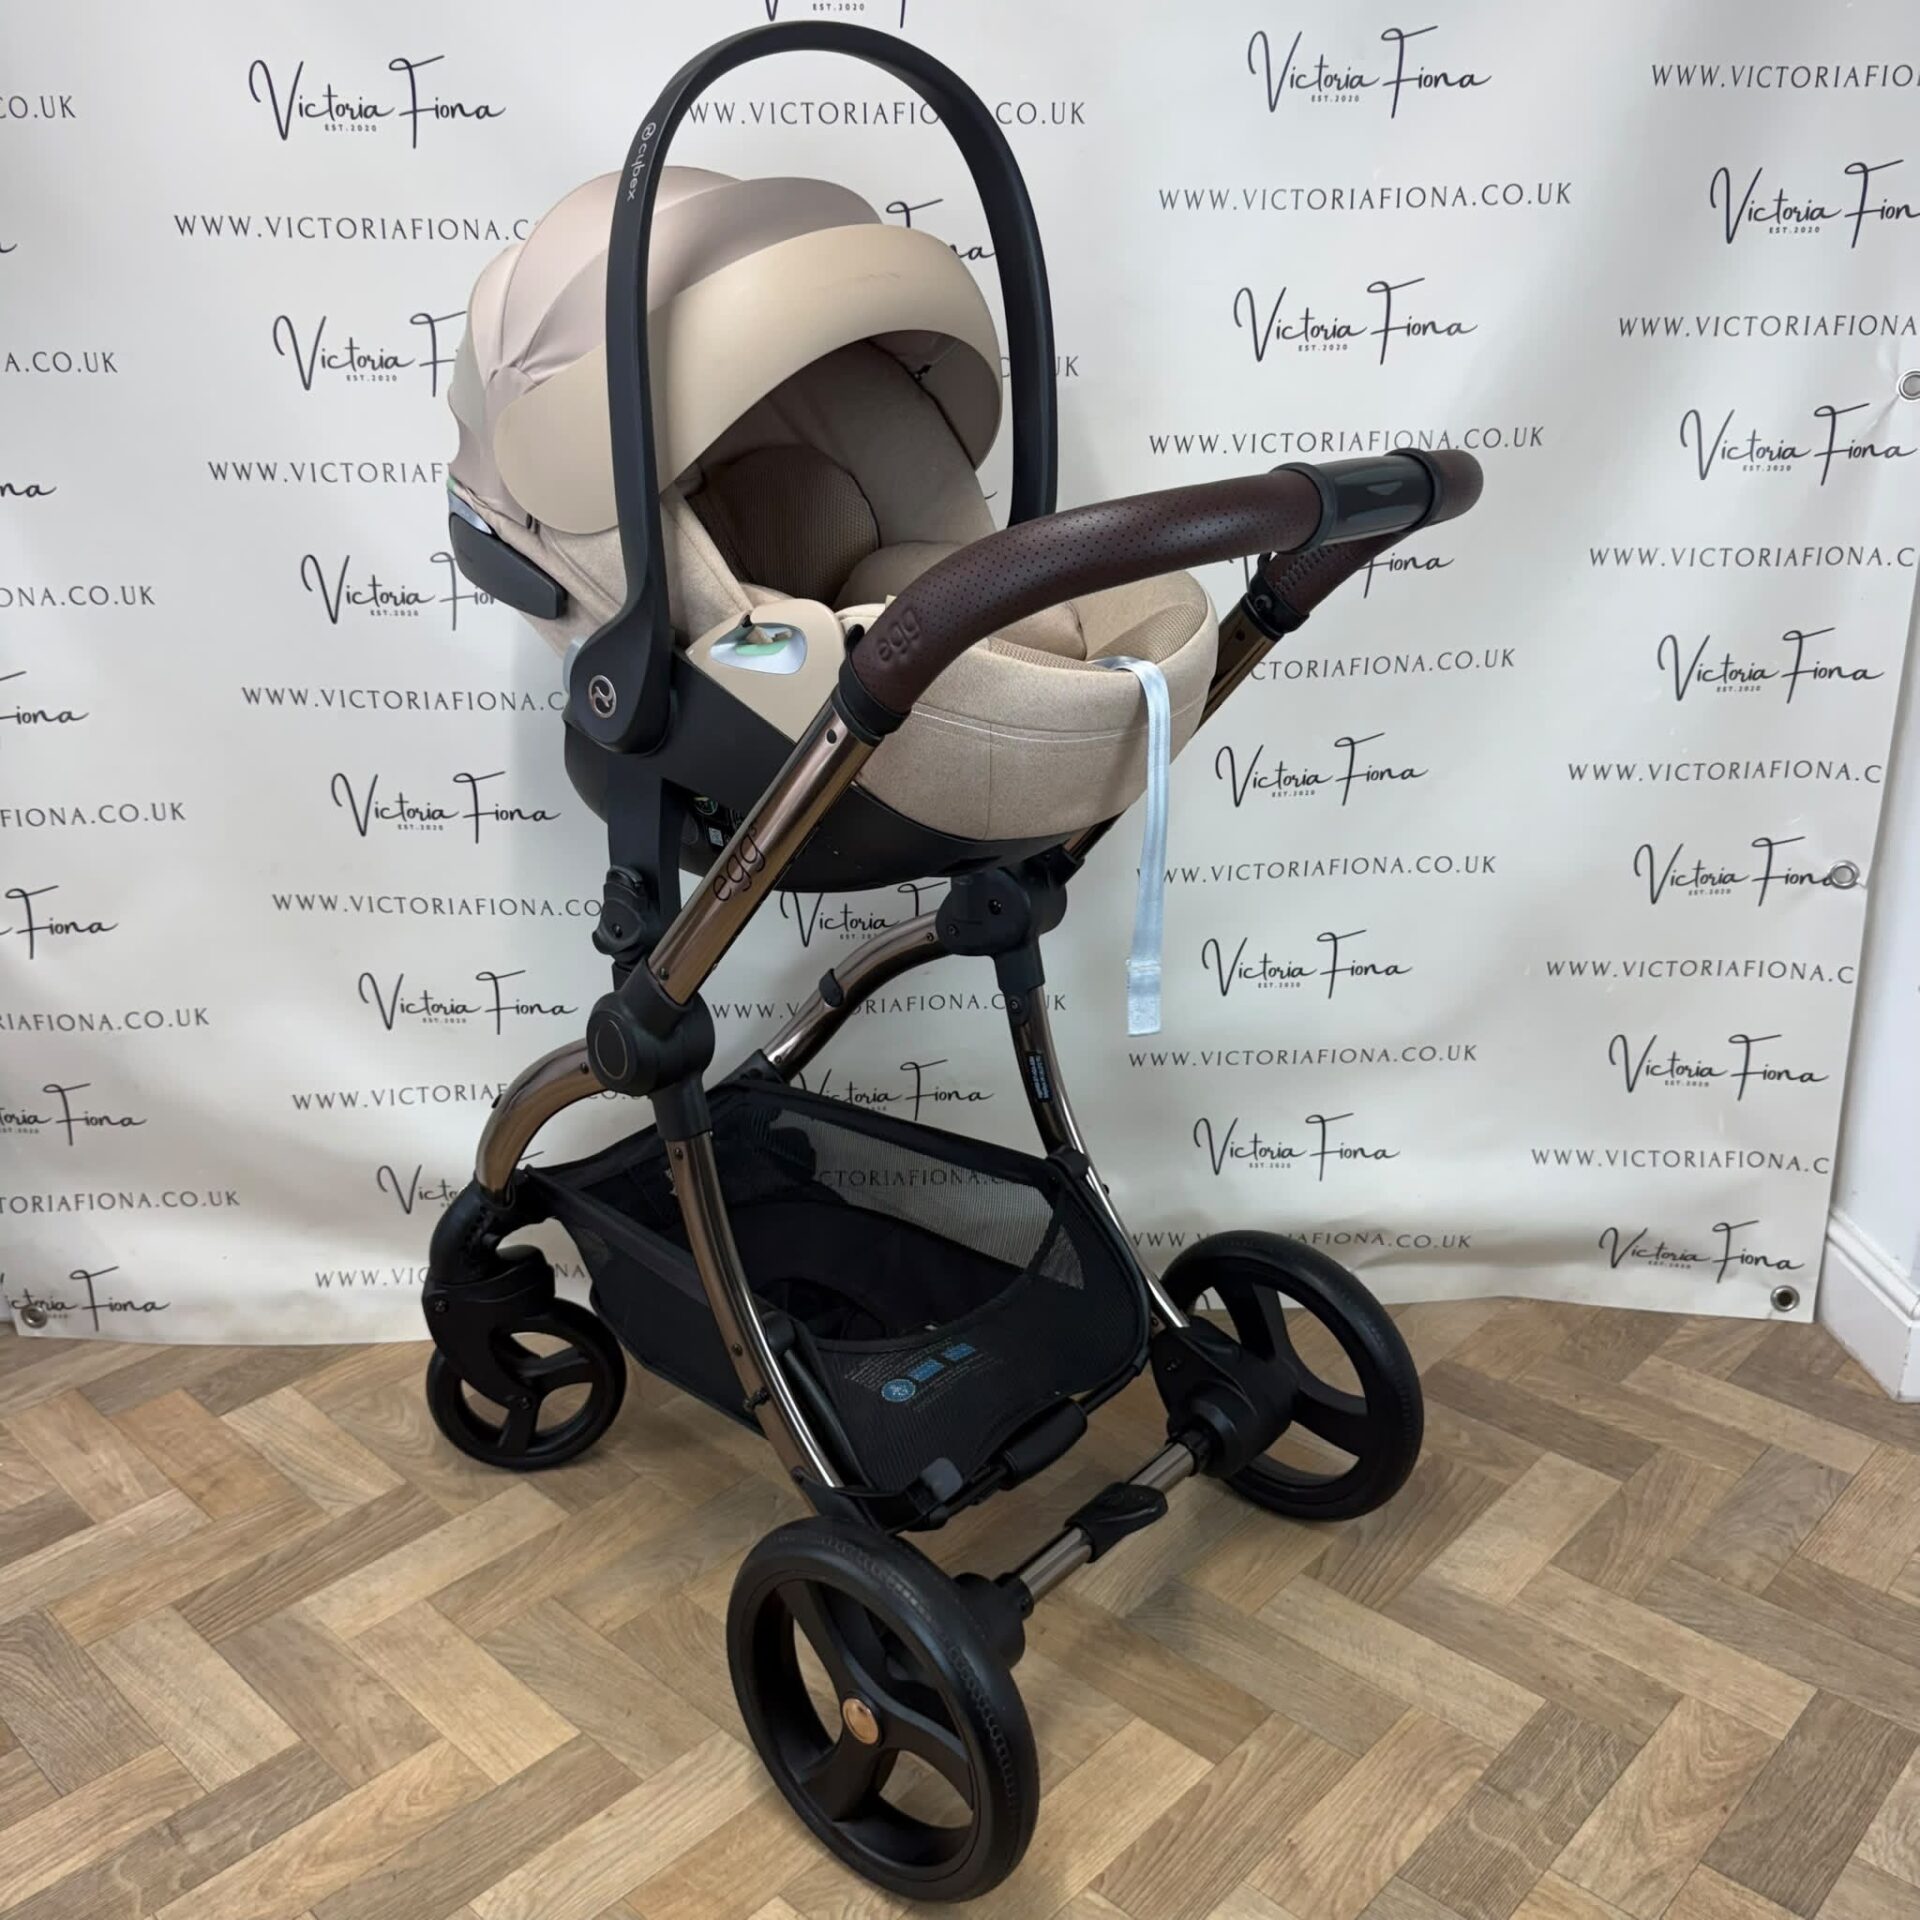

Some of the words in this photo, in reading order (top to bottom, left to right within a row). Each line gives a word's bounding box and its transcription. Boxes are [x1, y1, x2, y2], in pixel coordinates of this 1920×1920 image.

[812, 3, 865, 11] EST.2020
[249, 60, 396, 140] Victoria
[389, 55, 506, 149] Fiona
[1248, 30, 1380, 112] Victoria
[1381, 26, 1492, 118] Fiona
[1311, 94, 1360, 103] EST.2020
[1651, 65, 1920, 88] WWW.VICTORIAFIO
[324, 124, 377, 132] EST.2020
[626, 142, 648, 202] cybex
[1159, 182, 1572, 211] WWW.VICTORIAFIONA.CO.UK
[174, 215, 529, 241] WWW.VICTORIAFIONA.C
[1710, 167, 1842, 244] Victoria
[1844, 160, 1920, 249] Fion
[1769, 226, 1820, 234] EST.2020
[1234, 287, 1367, 362] Victoria
[1367, 278, 1478, 365] Fiona
[1298, 343, 1348, 352] EST.2020
[1618, 315, 1917, 338] WWW.VICTORIAFIONA
[273, 315, 416, 391] Victoria
[346, 374, 397, 382] EST.2020
[208, 462, 442, 484] WWW.VICTORIAF
[1680, 409, 1812, 480] Victoria
[1813, 403, 1918, 486] Fiona
[1590, 547, 1914, 567] WWW.VICTORIAFIONA.C
[301, 555, 435, 624] Victoria
[430, 552, 495, 631] Fio
[1251, 648, 1516, 681] CTORIAFIONA.CO.UK
[1657, 634, 1780, 701] Victoria
[1781, 627, 1885, 704] Fiona
[0, 671, 89, 725] iona
[242, 687, 564, 711] WWW.VICTORIAFIONA.C
[1215, 744, 1334, 808] Victoria
[1333, 732, 1428, 806] Fiona
[1568, 760, 1882, 784] WWW.VICTORIAFIONA.C
[331, 773, 459, 837] Victoria
[453, 771, 561, 844] Fiona
[713, 833, 766, 902] egg
[1136, 856, 1496, 886] WW.VICTORIAFIONA.CO.UK
[1634, 843, 1749, 905] Victoria
[5, 886, 119, 960] Fiona
[272, 894, 601, 917] WWW.VICTORIAFIONA.CO
[1202, 937, 1316, 996] Victoria
[1317, 930, 1413, 999] Fiona
[1546, 960, 1854, 984] WWW.VICTORIAFIONA.C
[358, 972, 481, 1031] Victoria
[475, 970, 578, 1035] Fiona
[1129, 1045, 1477, 1067] WWW.VICTORIAFIONA.CO.UK
[1609, 1034, 1727, 1093] Victoria
[1728, 1034, 1830, 1101] Fiona
[43, 1083, 147, 1146] Fiona
[900, 1059, 994, 1121] Fiona
[1194, 1117, 1307, 1175] Victoria
[1305, 1113, 1400, 1181] Fiona
[1531, 1148, 1829, 1175] WWW.VICTORIAFIONA.C
[1599, 1227, 1710, 1268] Victoria
[1712, 1220, 1805, 1283] Fiona
[70, 1266, 170, 1332] Fiona
